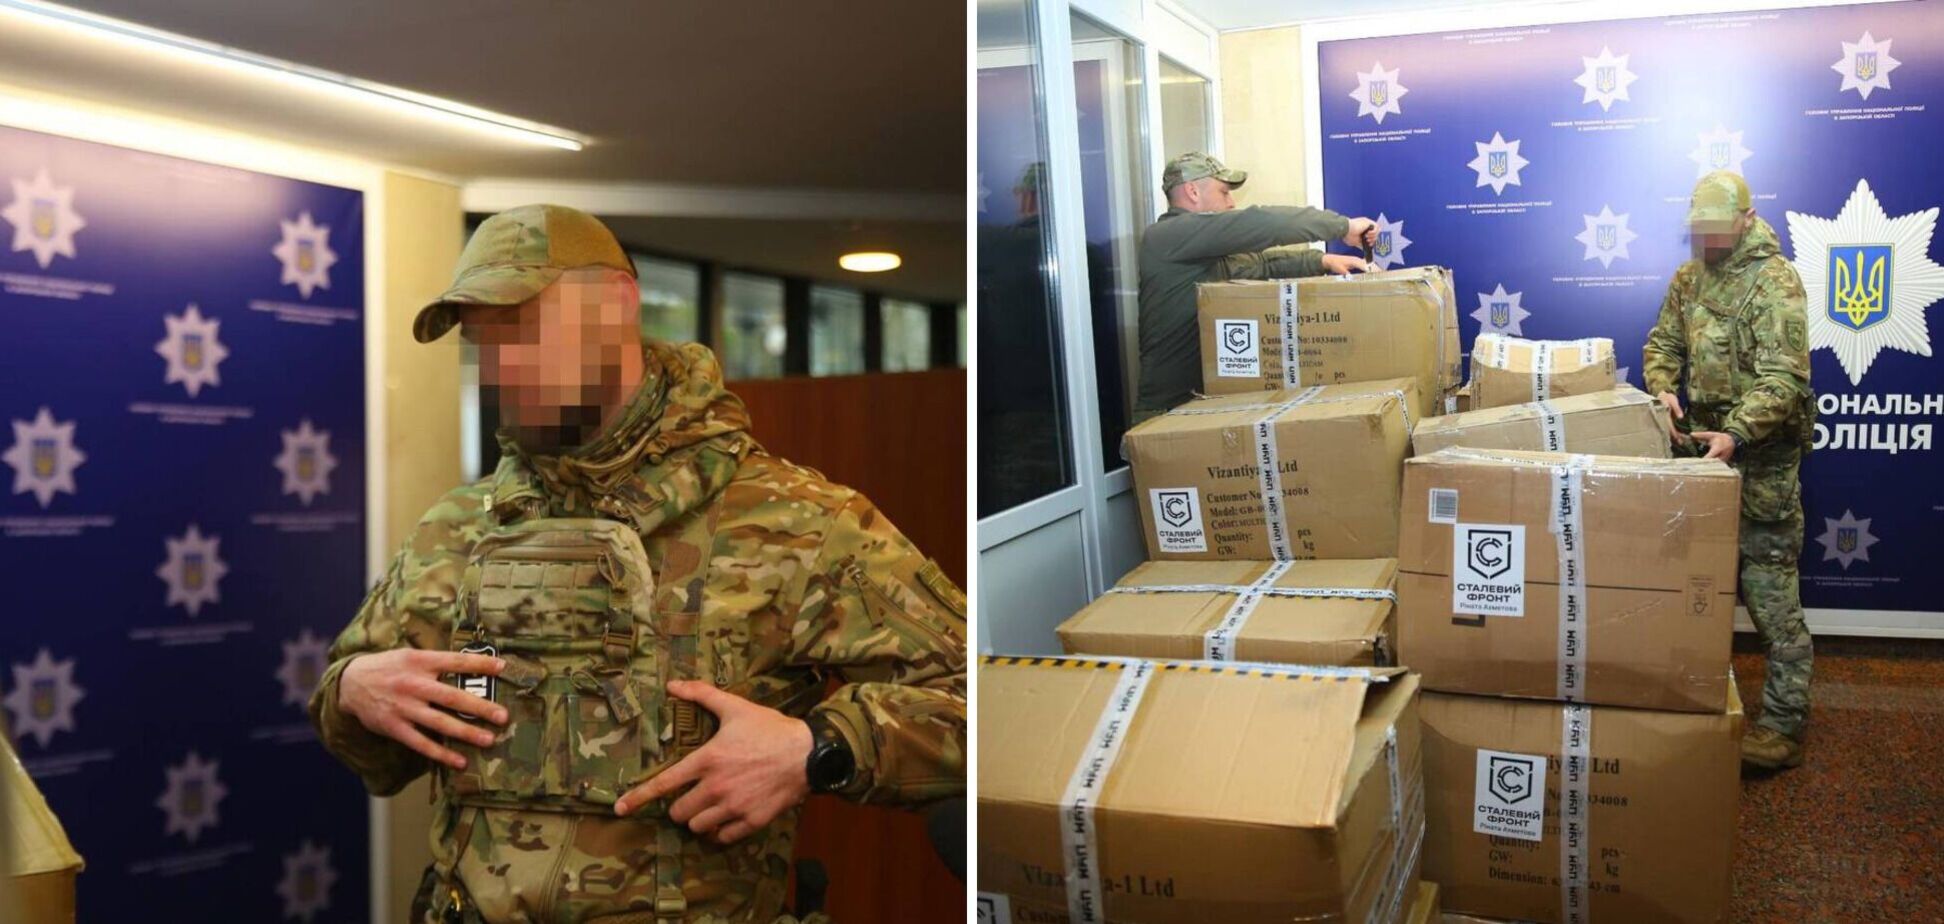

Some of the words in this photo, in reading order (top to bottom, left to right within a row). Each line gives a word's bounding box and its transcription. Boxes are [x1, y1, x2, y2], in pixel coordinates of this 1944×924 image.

[1817, 393, 1944, 415] ОНАЛЬН
[1812, 423, 1933, 455] ОЛІЦІЯ
[1278, 460, 1298, 473] Ltd
[1206, 492, 1247, 503] Customer
[1159, 529, 1203, 537] СТАЛЕВИЙ
[1214, 532, 1253, 544] Quantity:
[1457, 583, 1522, 594] СТАЛЕВИЙ
[1466, 593, 1511, 603] ФРОНТ
[1593, 757, 1620, 774] Ltd
[1478, 805, 1541, 820] СТАЛЕВИЙ
[1487, 815, 1530, 828] ФРОНТ
[1140, 876, 1175, 897] Ltd
